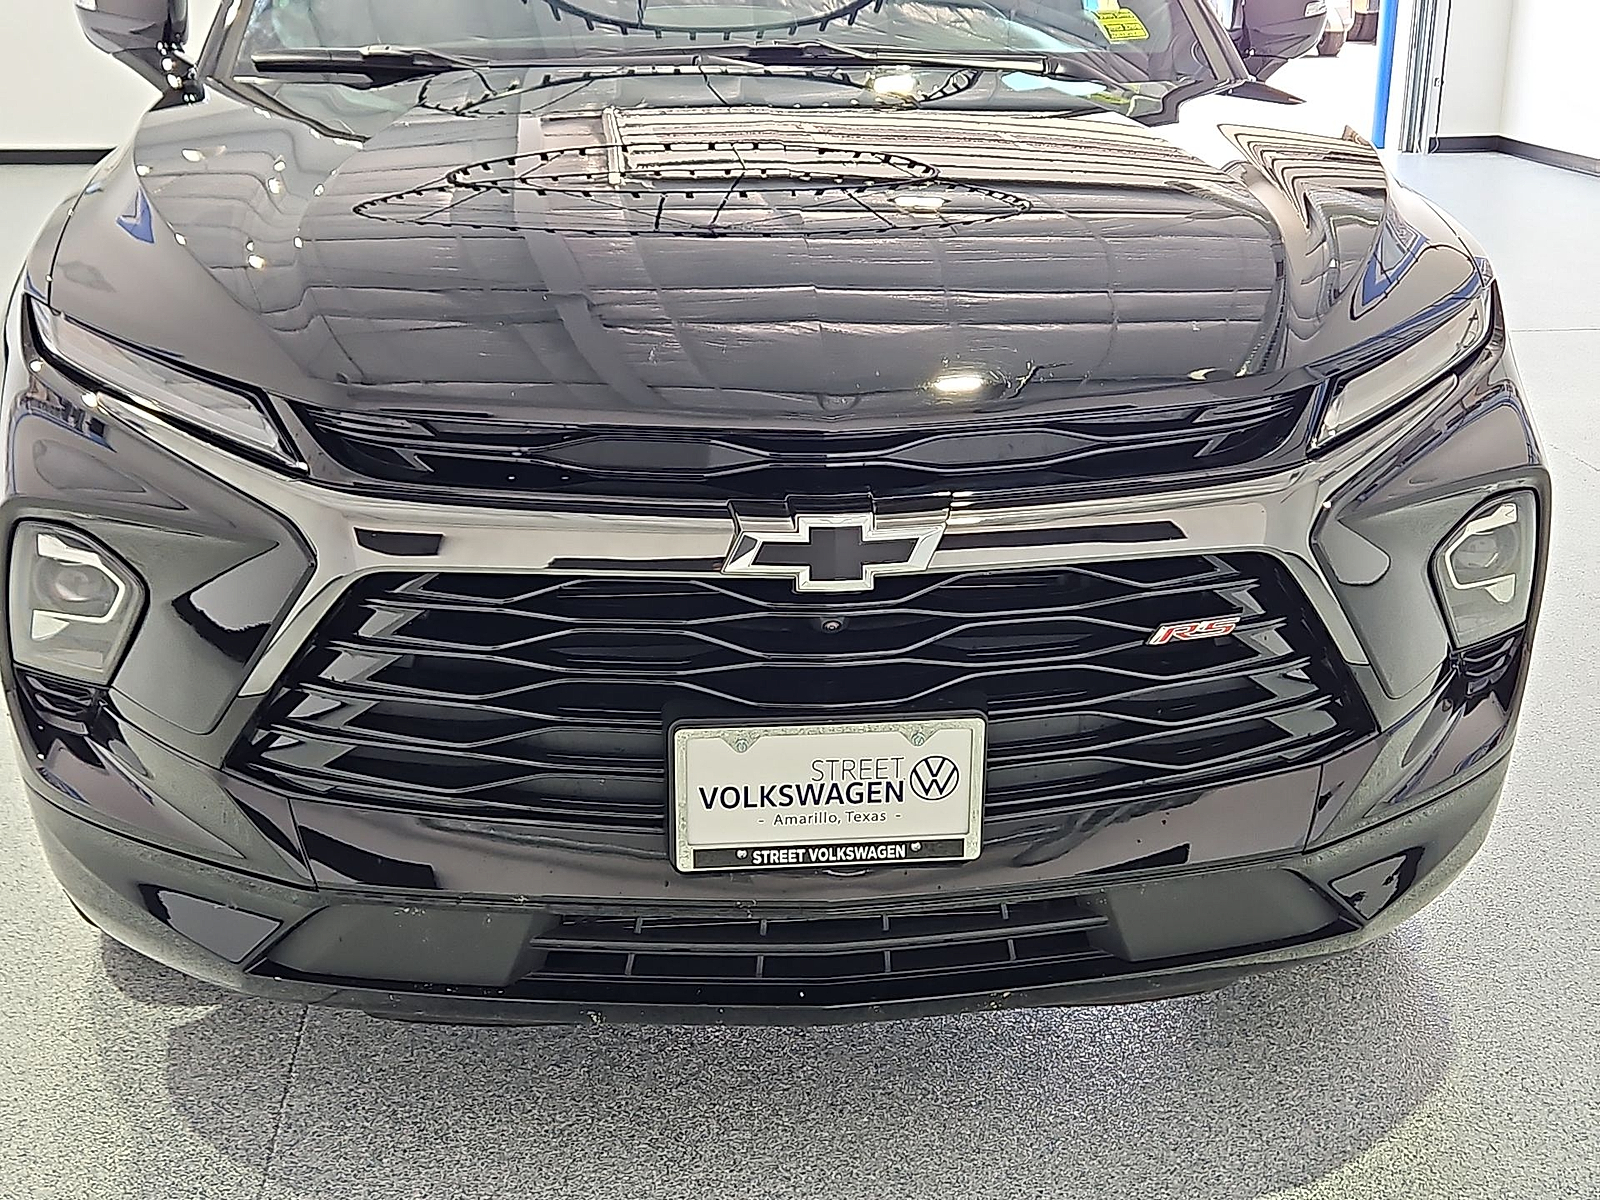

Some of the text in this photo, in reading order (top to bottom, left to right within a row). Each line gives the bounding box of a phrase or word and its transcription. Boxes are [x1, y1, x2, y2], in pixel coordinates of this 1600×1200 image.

[1150, 617, 1240, 645] RS
[811, 756, 905, 782] STREET
[699, 780, 904, 810] VOLKSWAGEN
[773, 810, 887, 826] Amarillo, Texas
[752, 844, 906, 865] STREET VOLKSWAGEN
